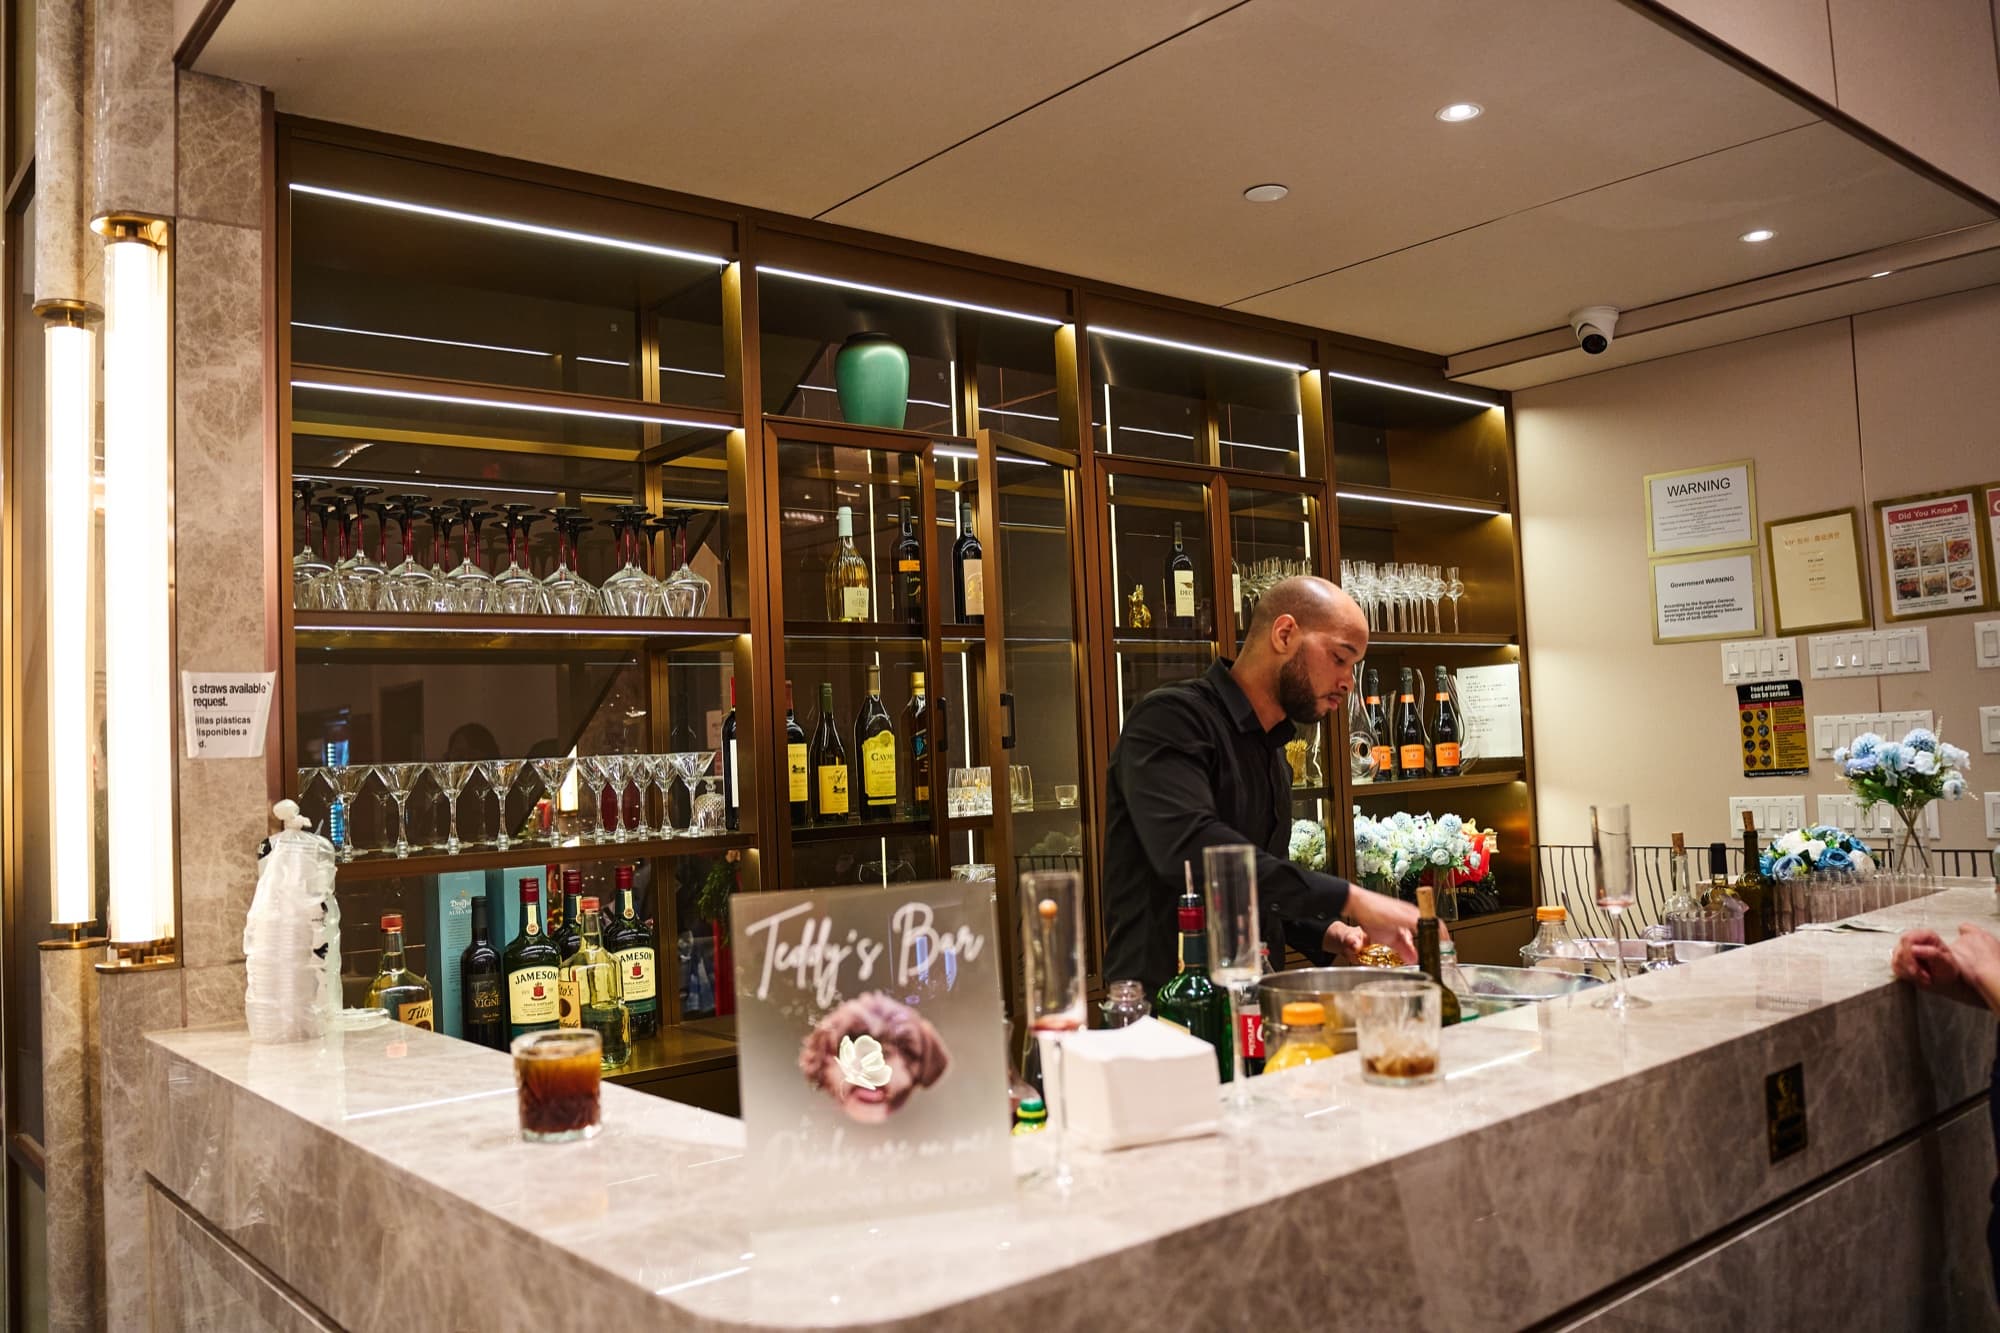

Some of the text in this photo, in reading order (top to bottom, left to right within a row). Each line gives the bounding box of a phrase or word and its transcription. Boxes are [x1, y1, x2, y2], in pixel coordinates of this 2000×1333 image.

[1667, 477, 1731, 497] WARNING
[1898, 503, 1958, 521] Did You Know?
[1670, 575, 1735, 589] Government WARNING
[199, 684, 227, 694] straws
[229, 682, 267, 694] available
[1765, 683, 1789, 692] allergies
[1769, 690, 1791, 698] serious
[193, 697, 228, 710] request.
[242, 728, 247, 736] a
[620, 951, 653, 963] AMESON
[745, 900, 985, 1008] Teddy's Bar
[515, 970, 558, 985] JAMESON
